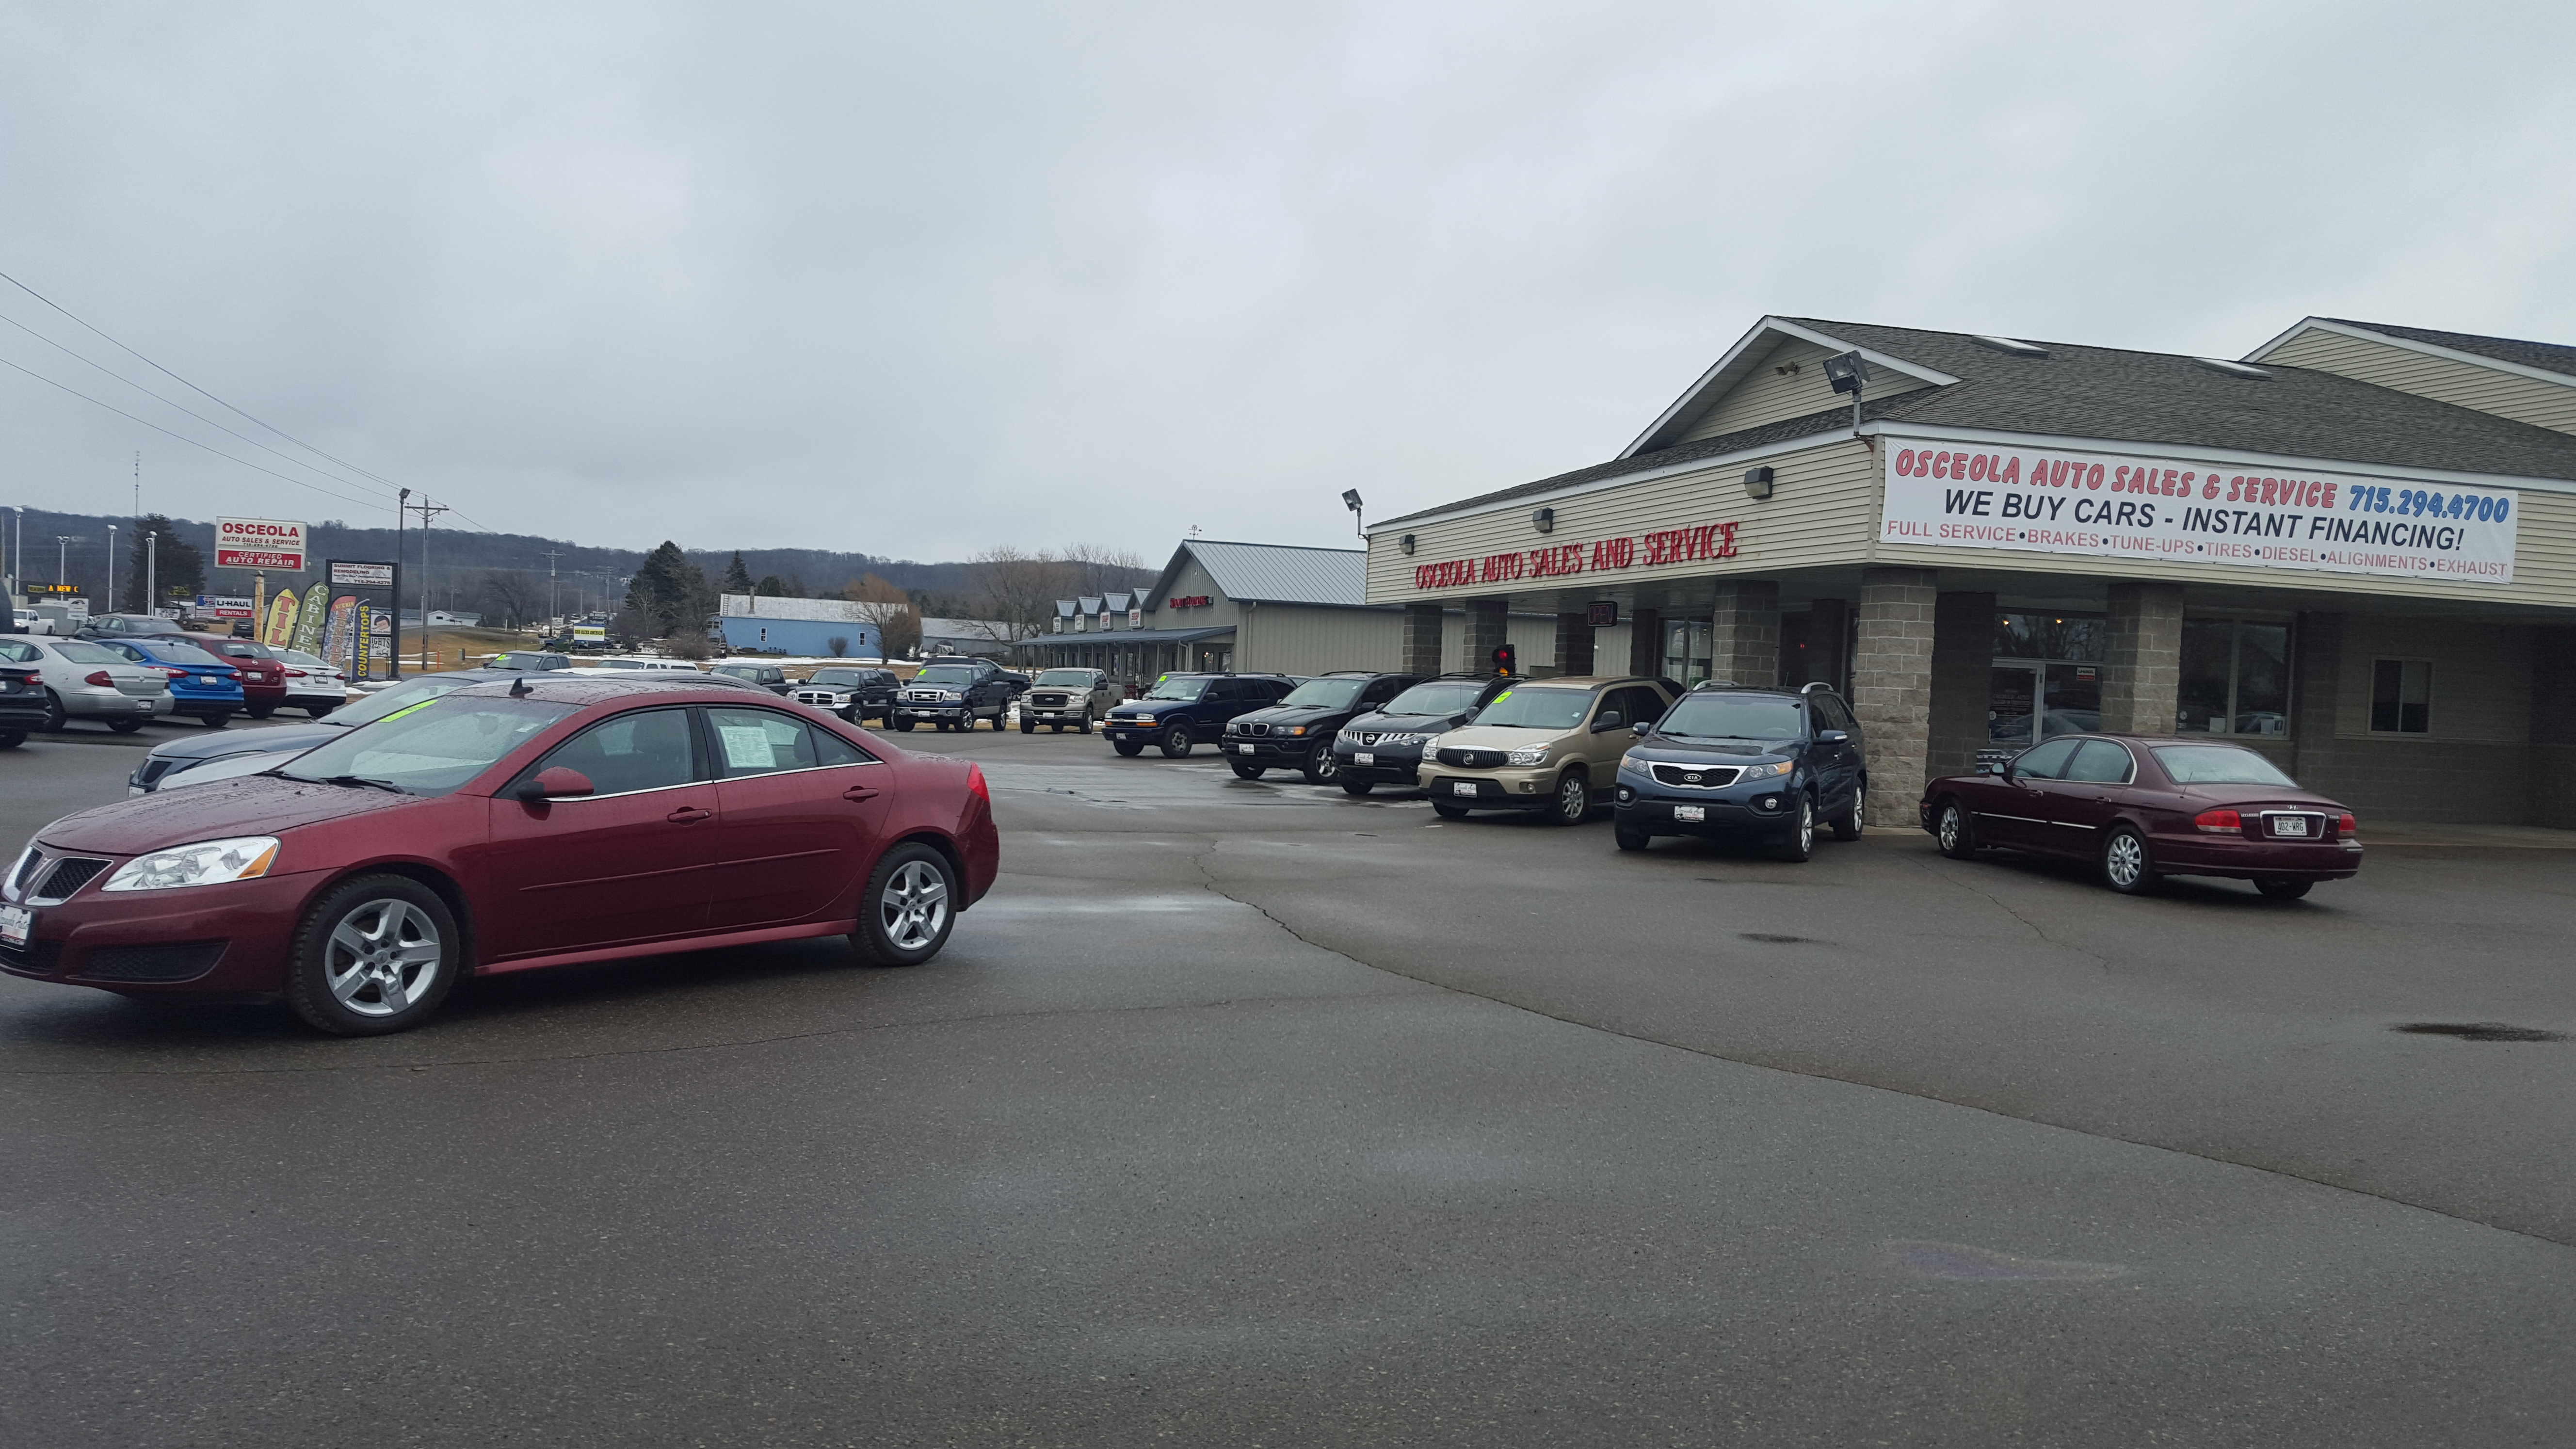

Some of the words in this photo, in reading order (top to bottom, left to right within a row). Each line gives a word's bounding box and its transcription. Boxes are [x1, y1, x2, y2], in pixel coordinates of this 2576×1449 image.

[1896, 449, 2020, 484] OSCEOLA
[2030, 459, 2105, 490] AUTO
[2111, 466, 2195, 497] SALES
[2203, 474, 2220, 499] &
[2227, 476, 2337, 508] SERVICE
[2349, 485, 2509, 523] 715.294.4700
[222, 522, 299, 537] OSCEOLA
[1887, 520, 1933, 537] FULL
[1939, 523, 2016, 542] SERVICE
[2028, 529, 2099, 547] BRAKES
[2110, 534, 2194, 554] TUNE-UPS
[2205, 541, 2252, 559] TIRES
[2262, 546, 2318, 563] DIESEL
[2327, 550, 2427, 571] ALIGNMENTS
[2437, 558, 2508, 576] EXHAUST
[1945, 488, 1994, 516] WE
[2001, 493, 2067, 521] BUY
[2075, 498, 2155, 528] CARS
[2182, 507, 2303, 538] INSTANT
[2308, 516, 2464, 551] FINANCING!
[1416, 559, 1476, 589] OSCEOLA
[1481, 551, 1523, 582] AUTO
[1529, 543, 1583, 578] SALES
[1591, 537, 1633, 571] AND
[1643, 521, 1738, 565] SERVICE
[295, 585, 327, 653] CABINET
[357, 605, 370, 677] COUNTERTOPS
[1589, 605, 1612, 624] OPEN
[2278, 821, 2303, 831] 402-WRG
